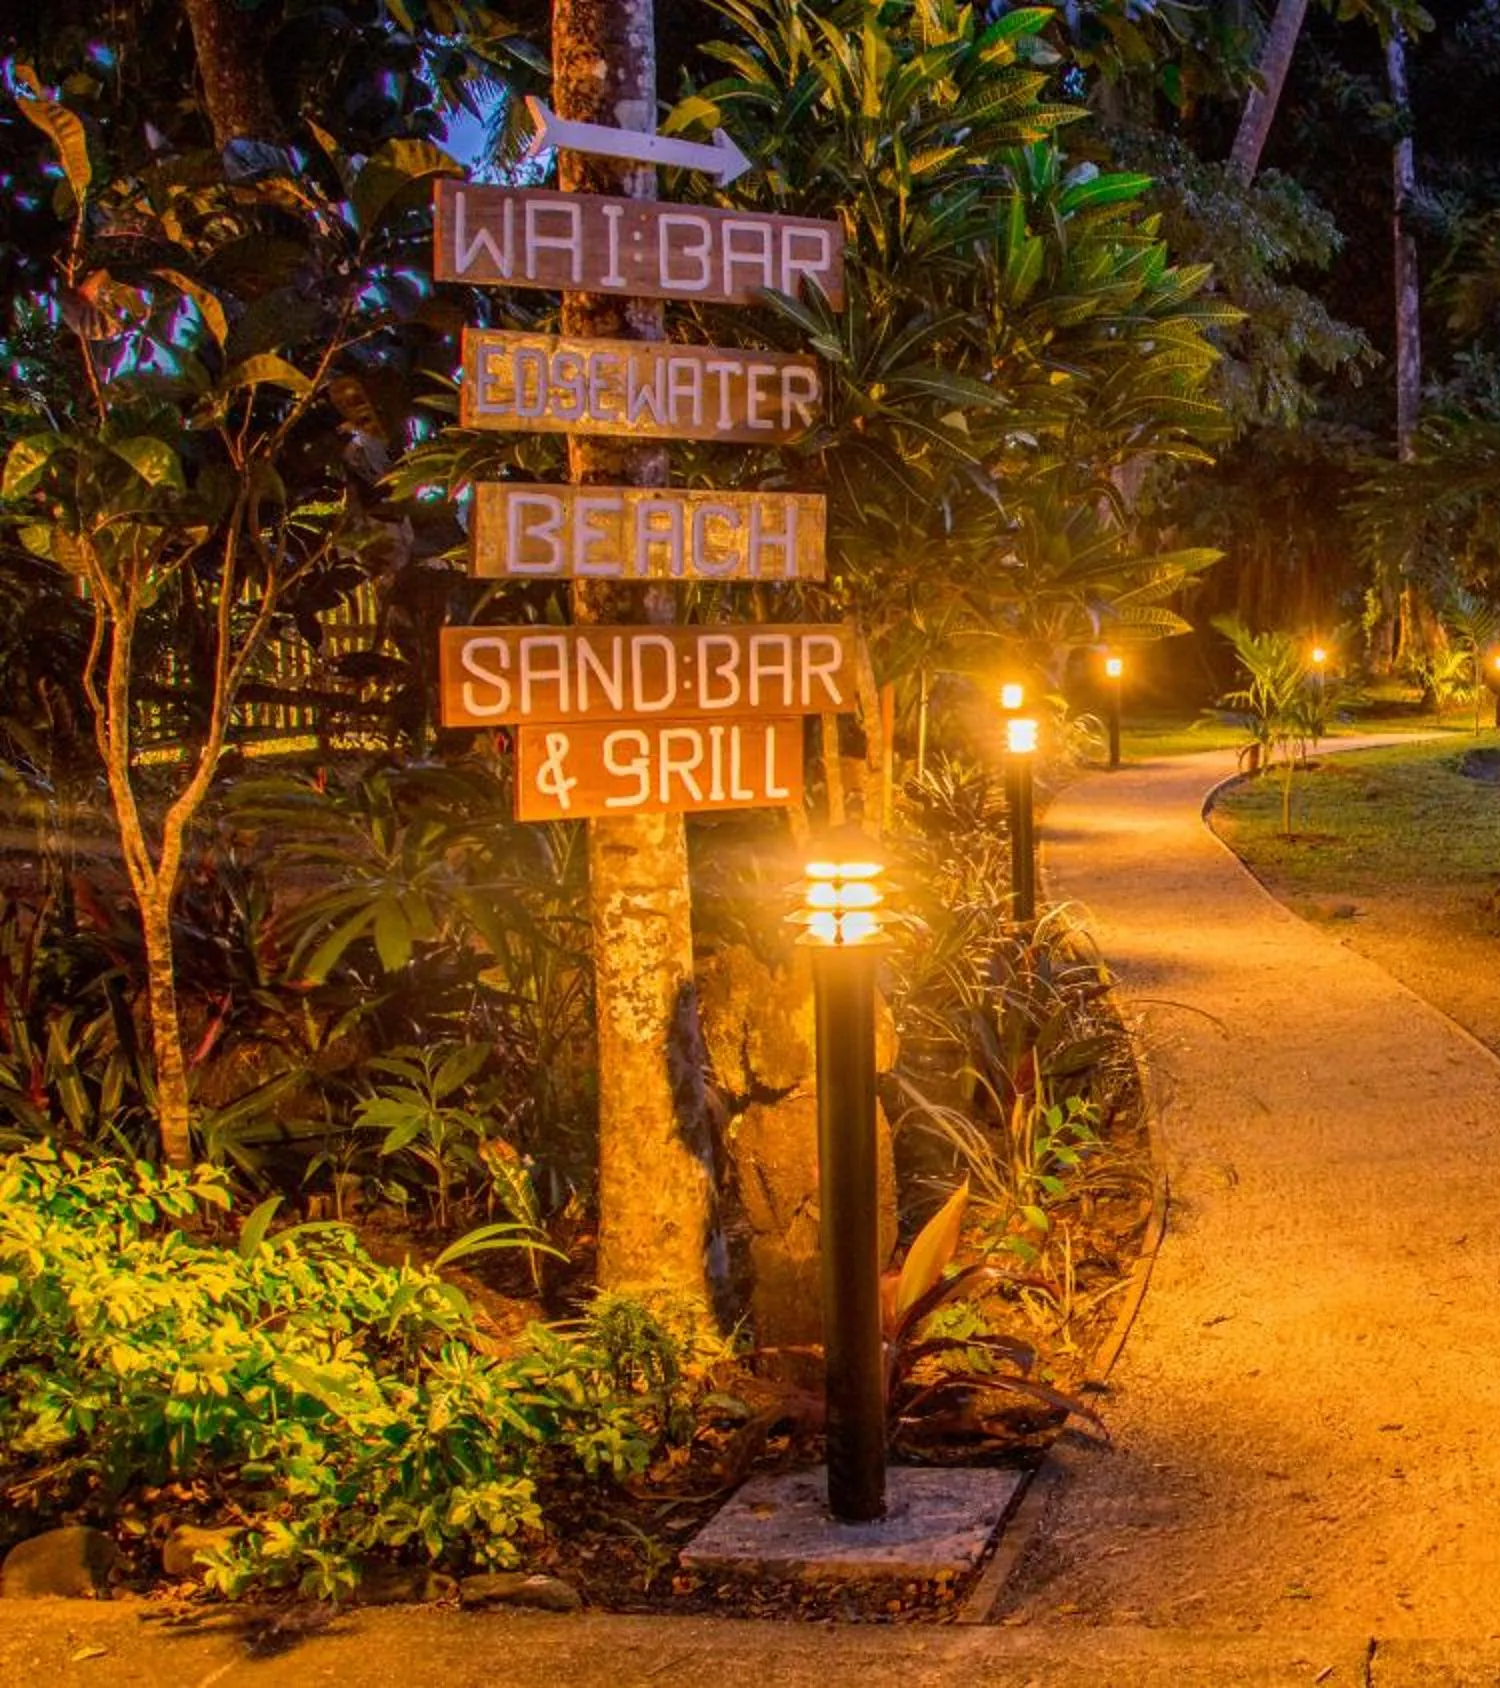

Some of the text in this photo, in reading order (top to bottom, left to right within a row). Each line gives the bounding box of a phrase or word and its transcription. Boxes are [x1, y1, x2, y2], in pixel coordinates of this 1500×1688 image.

[506, 492, 798, 576] BEACH
[536, 725, 790, 810] & GRILL
